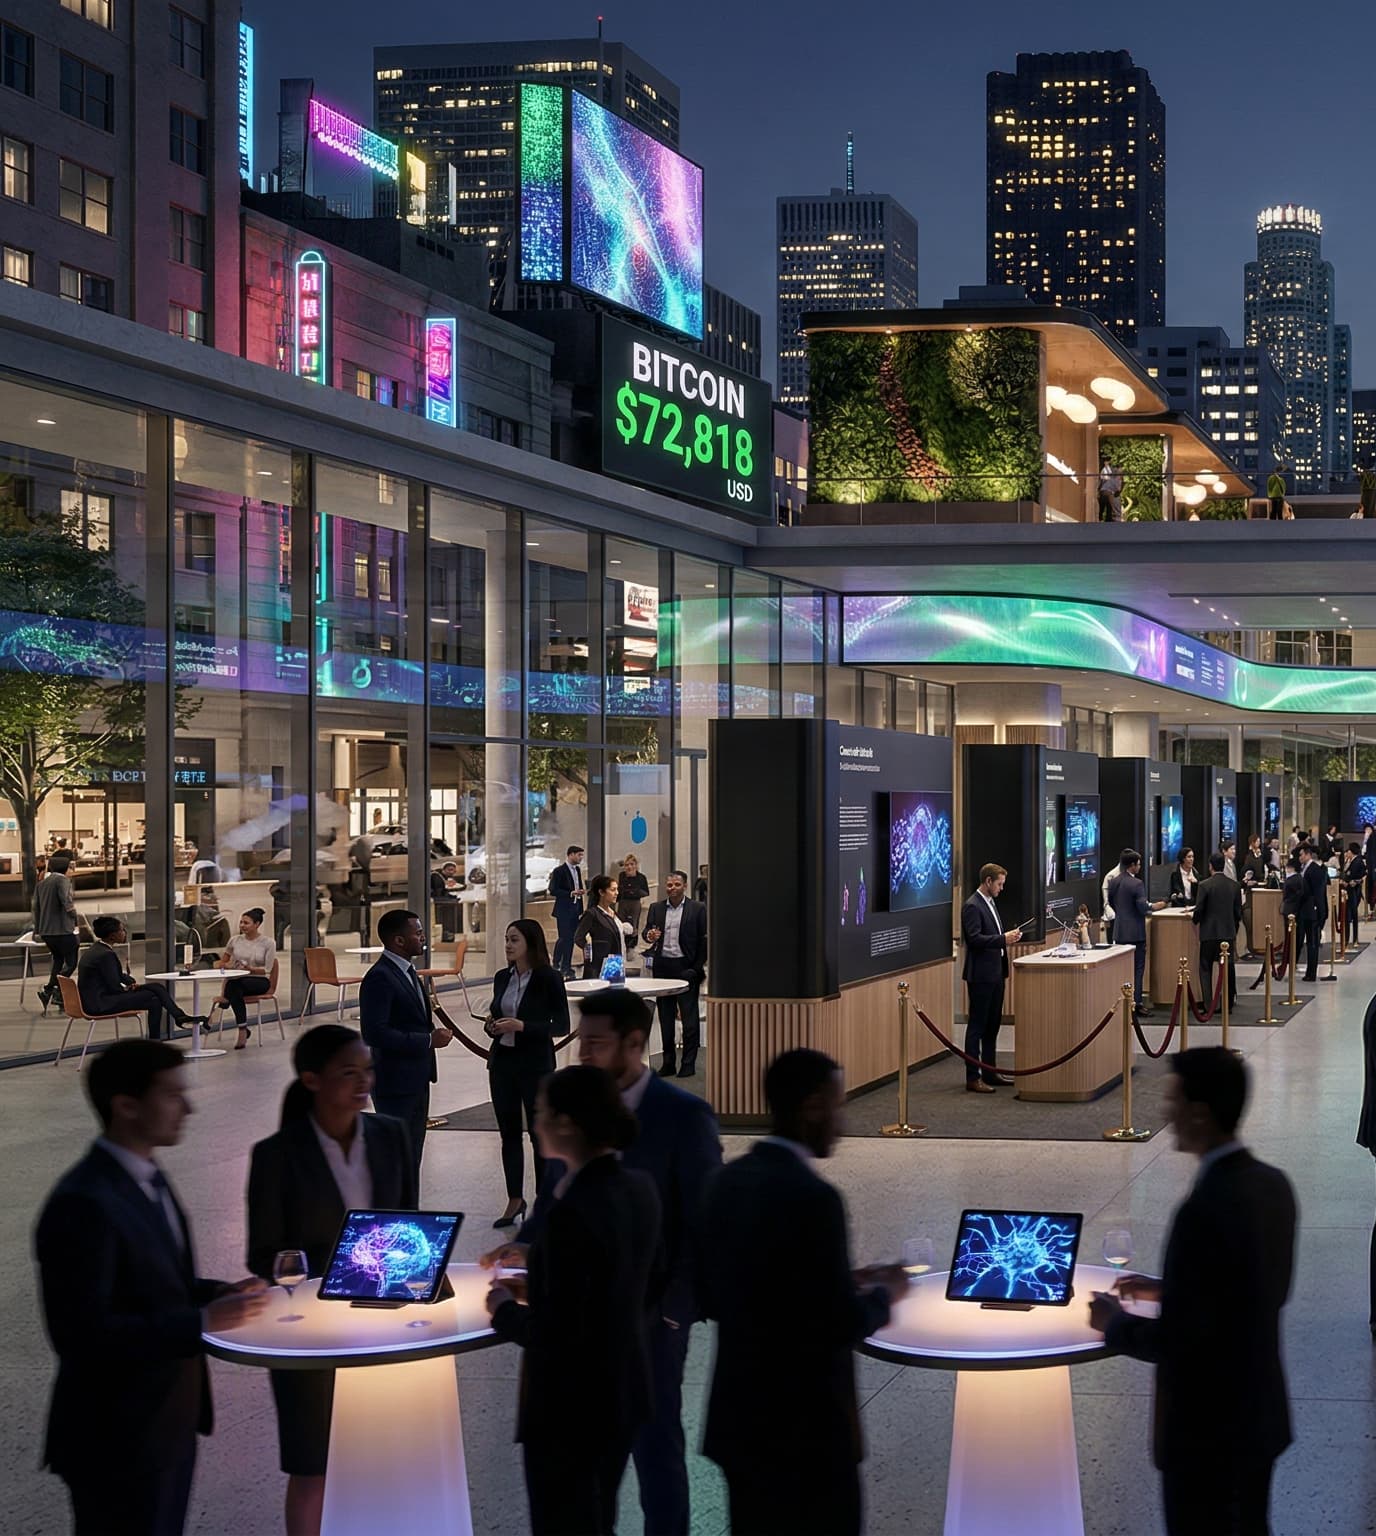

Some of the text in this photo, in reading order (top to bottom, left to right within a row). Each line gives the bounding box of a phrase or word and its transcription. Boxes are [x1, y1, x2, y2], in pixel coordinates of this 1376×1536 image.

[633, 342, 744, 419] BITCOIN
[615, 381, 753, 477] $72,818
[727, 479, 753, 502] USD
